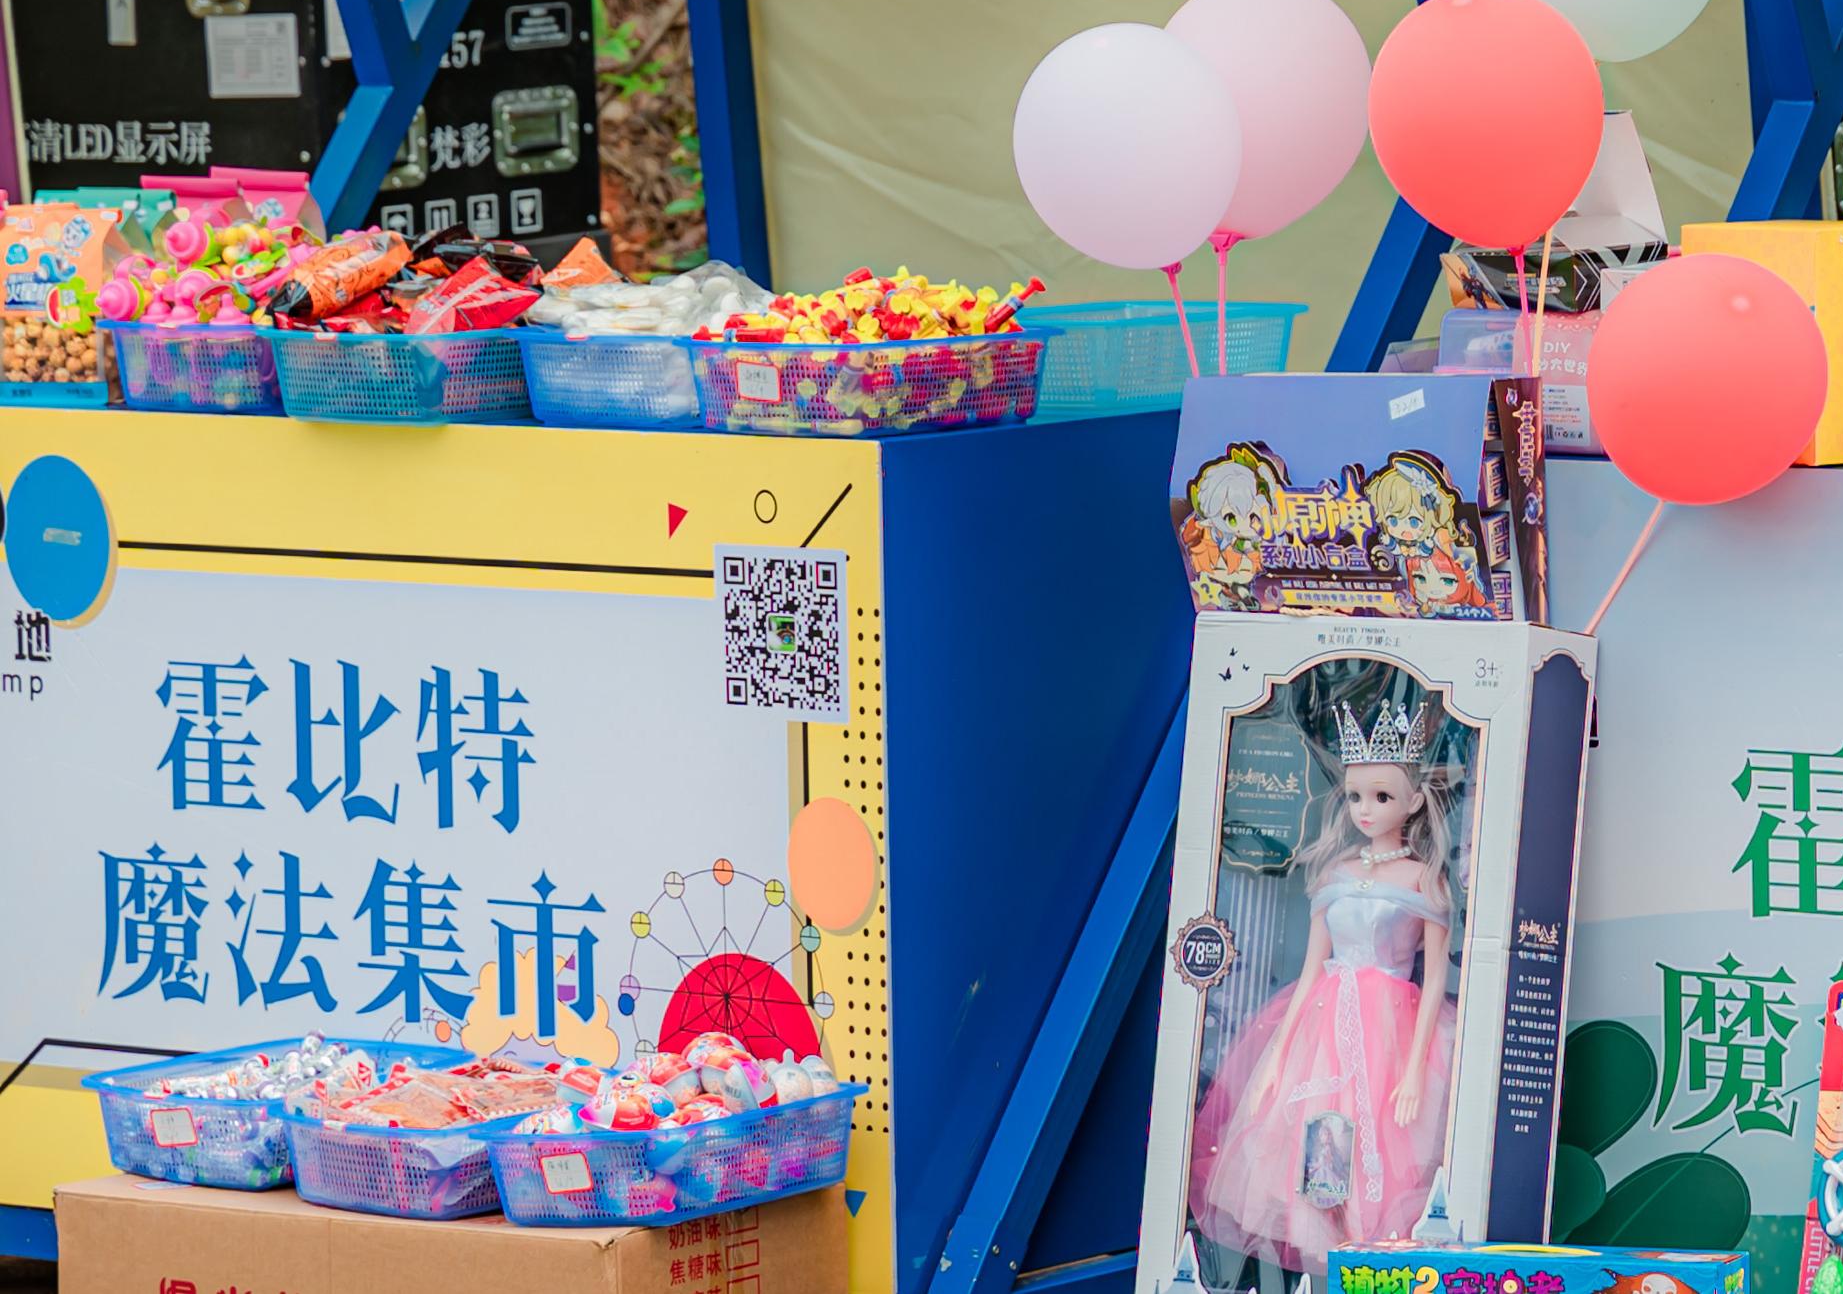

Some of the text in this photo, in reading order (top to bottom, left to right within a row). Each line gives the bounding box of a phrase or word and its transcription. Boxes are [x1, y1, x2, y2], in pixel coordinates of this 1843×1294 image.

[24, 118, 212, 165] 清LED显示屏
[430, 122, 492, 172] 梵彩
[1543, 341, 1571, 354] DIY
[1260, 542, 1371, 572] 系列小盲盒
[14, 609, 52, 662] 地
[1475, 657, 1498, 679] 3+
[155, 654, 536, 834] 霍比特
[95, 840, 608, 1039] 魔法集市
[668, 1216, 723, 1250] 奶油味
[669, 1250, 723, 1287] 焦糖味
